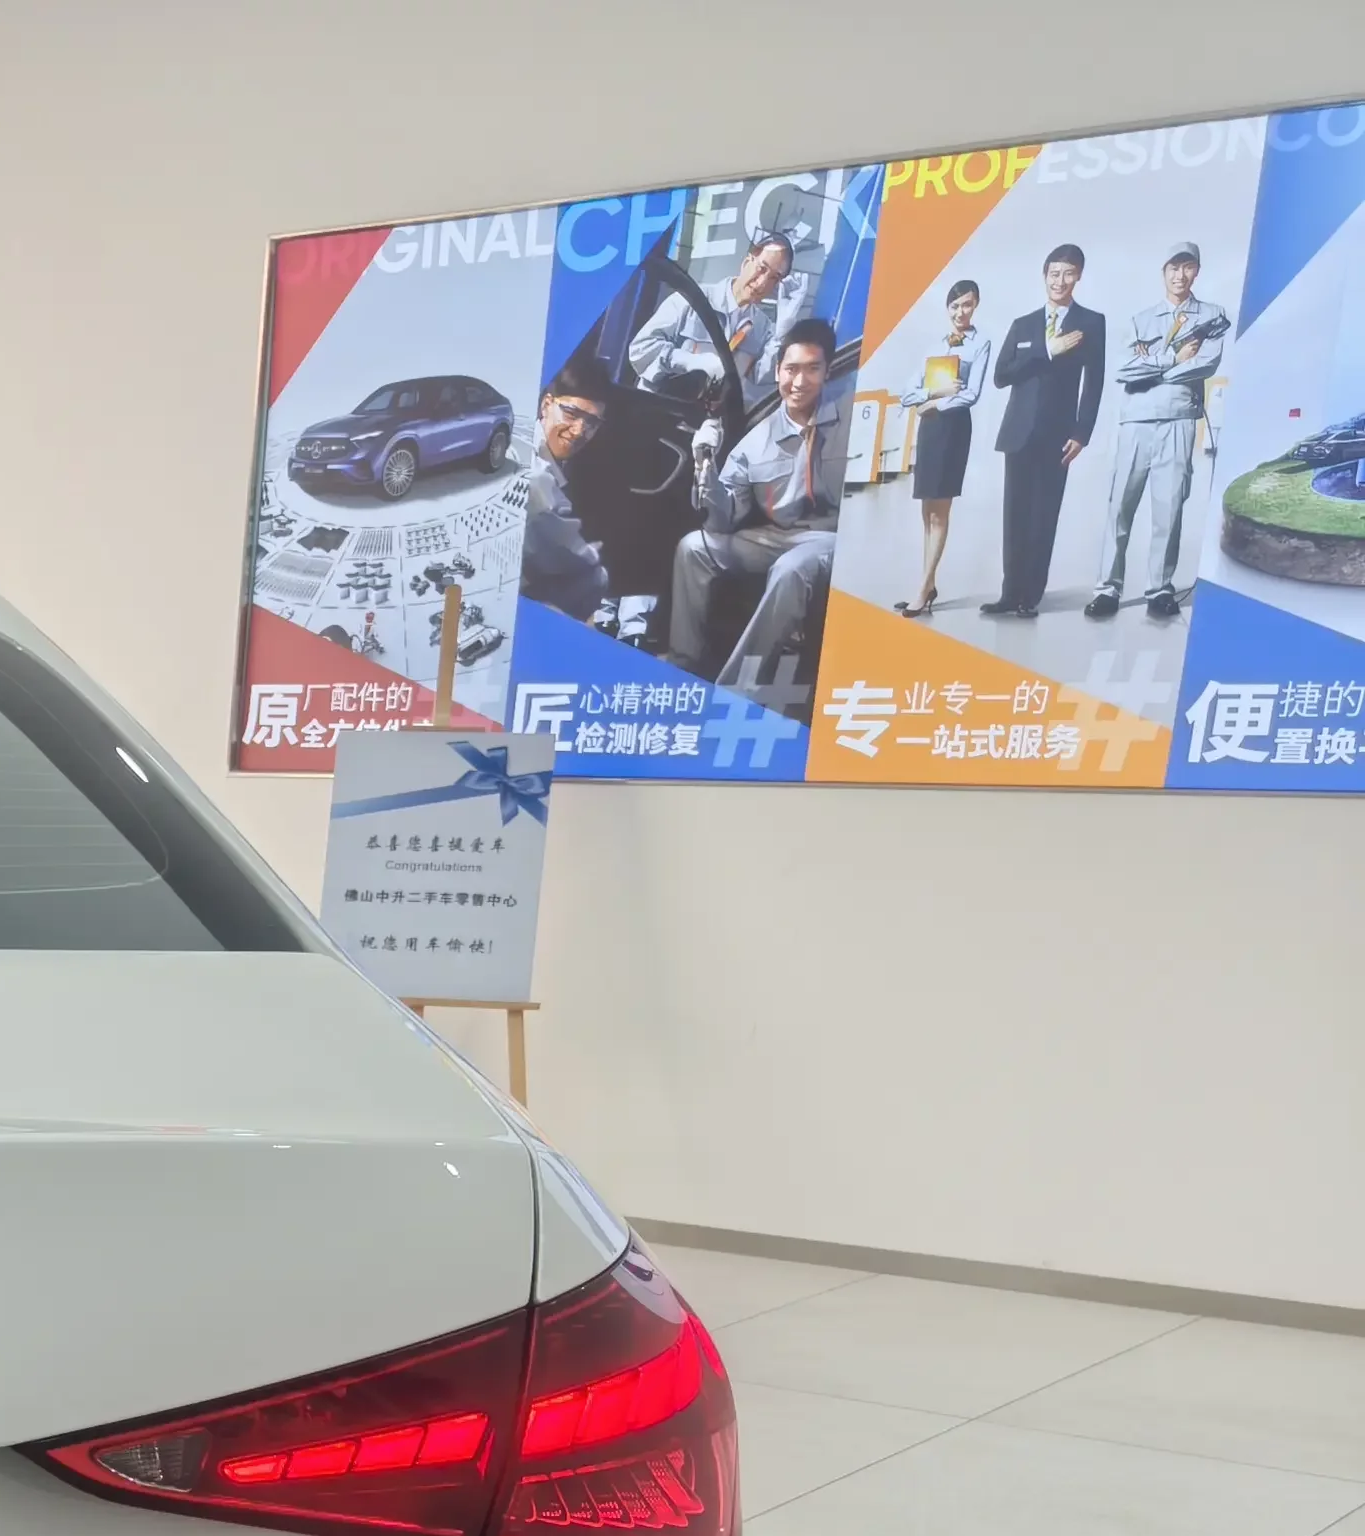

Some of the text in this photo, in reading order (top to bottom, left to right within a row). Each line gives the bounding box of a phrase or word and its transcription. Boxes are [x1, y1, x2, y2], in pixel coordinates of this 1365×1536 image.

[557, 164, 882, 272] CHECK
[575, 721, 701, 756] 检测修复
[896, 724, 1081, 759] 一站式服务
[1270, 727, 1365, 765] 置换
[385, 860, 482, 873] Congratulations
[344, 888, 517, 908] 佛山中升二手车零售中心
